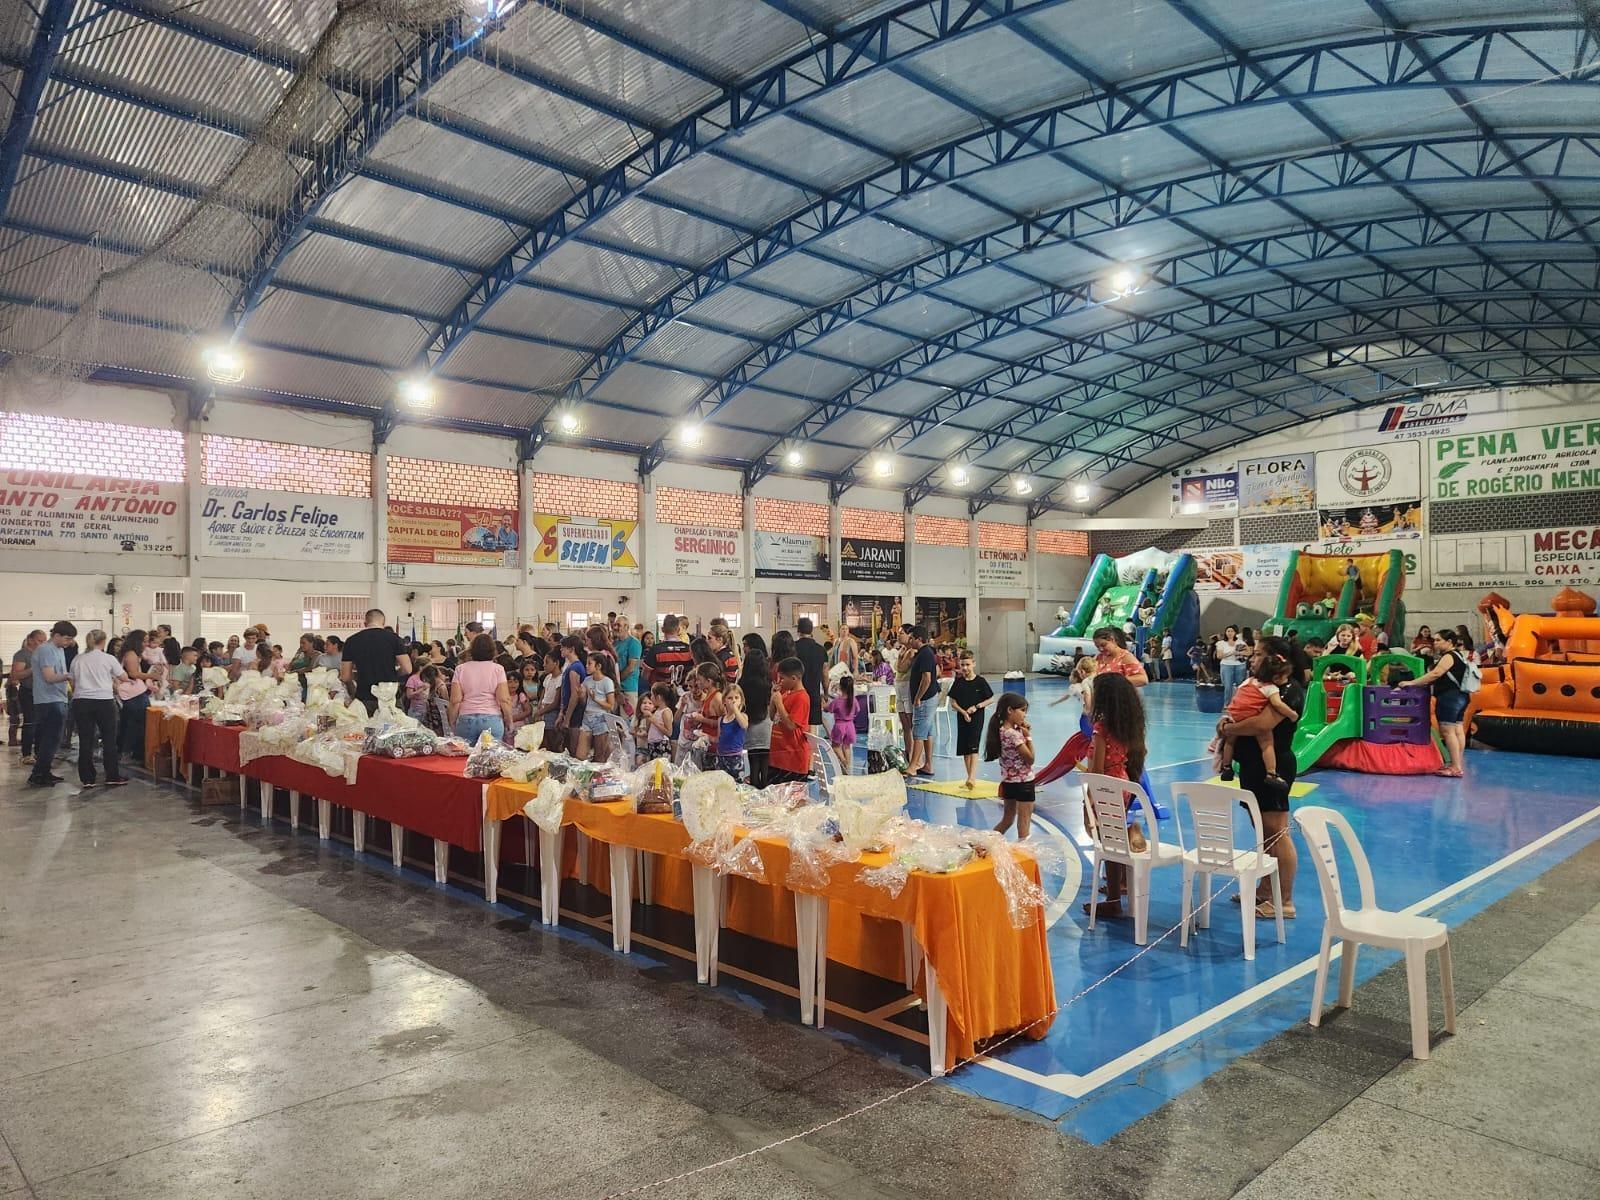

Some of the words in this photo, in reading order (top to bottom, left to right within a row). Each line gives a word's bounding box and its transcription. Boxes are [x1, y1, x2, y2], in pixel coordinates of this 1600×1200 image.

[1405, 399, 1468, 418] SOMA
[1437, 432, 1517, 461] PENA
[1480, 453, 1548, 466] PLANEJAMENTO
[1555, 449, 1597, 459] AGRÍCOLA
[1508, 463, 1559, 472] TOPOGRAFIA
[1570, 459, 1590, 467] LTDA
[1246, 459, 1306, 476] FLORA
[0, 471, 160, 496] UNILARIA
[1438, 481, 1459, 498] DE
[1467, 472, 1543, 496] ROGÉRIO
[74, 495, 177, 516] ANTÔNIO
[202, 498, 226, 518] Dr.
[231, 500, 287, 522] Carlos
[290, 504, 338, 528] Felipe
[60, 521, 75, 529] EM
[84, 522, 112, 531] GERAL
[100, 514, 159, 524] GALVANIZADO
[80, 531, 108, 540] SANTO
[309, 528, 320, 538] SE
[387, 526, 425, 536] CAPITAL
[427, 529, 439, 537] DE
[440, 529, 460, 538] GIRO
[674, 537, 736, 556] SERGINHO
[859, 546, 902, 562] JARANIT
[1535, 564, 1581, 576] CAIXA
[668, 664, 685, 684] 10
